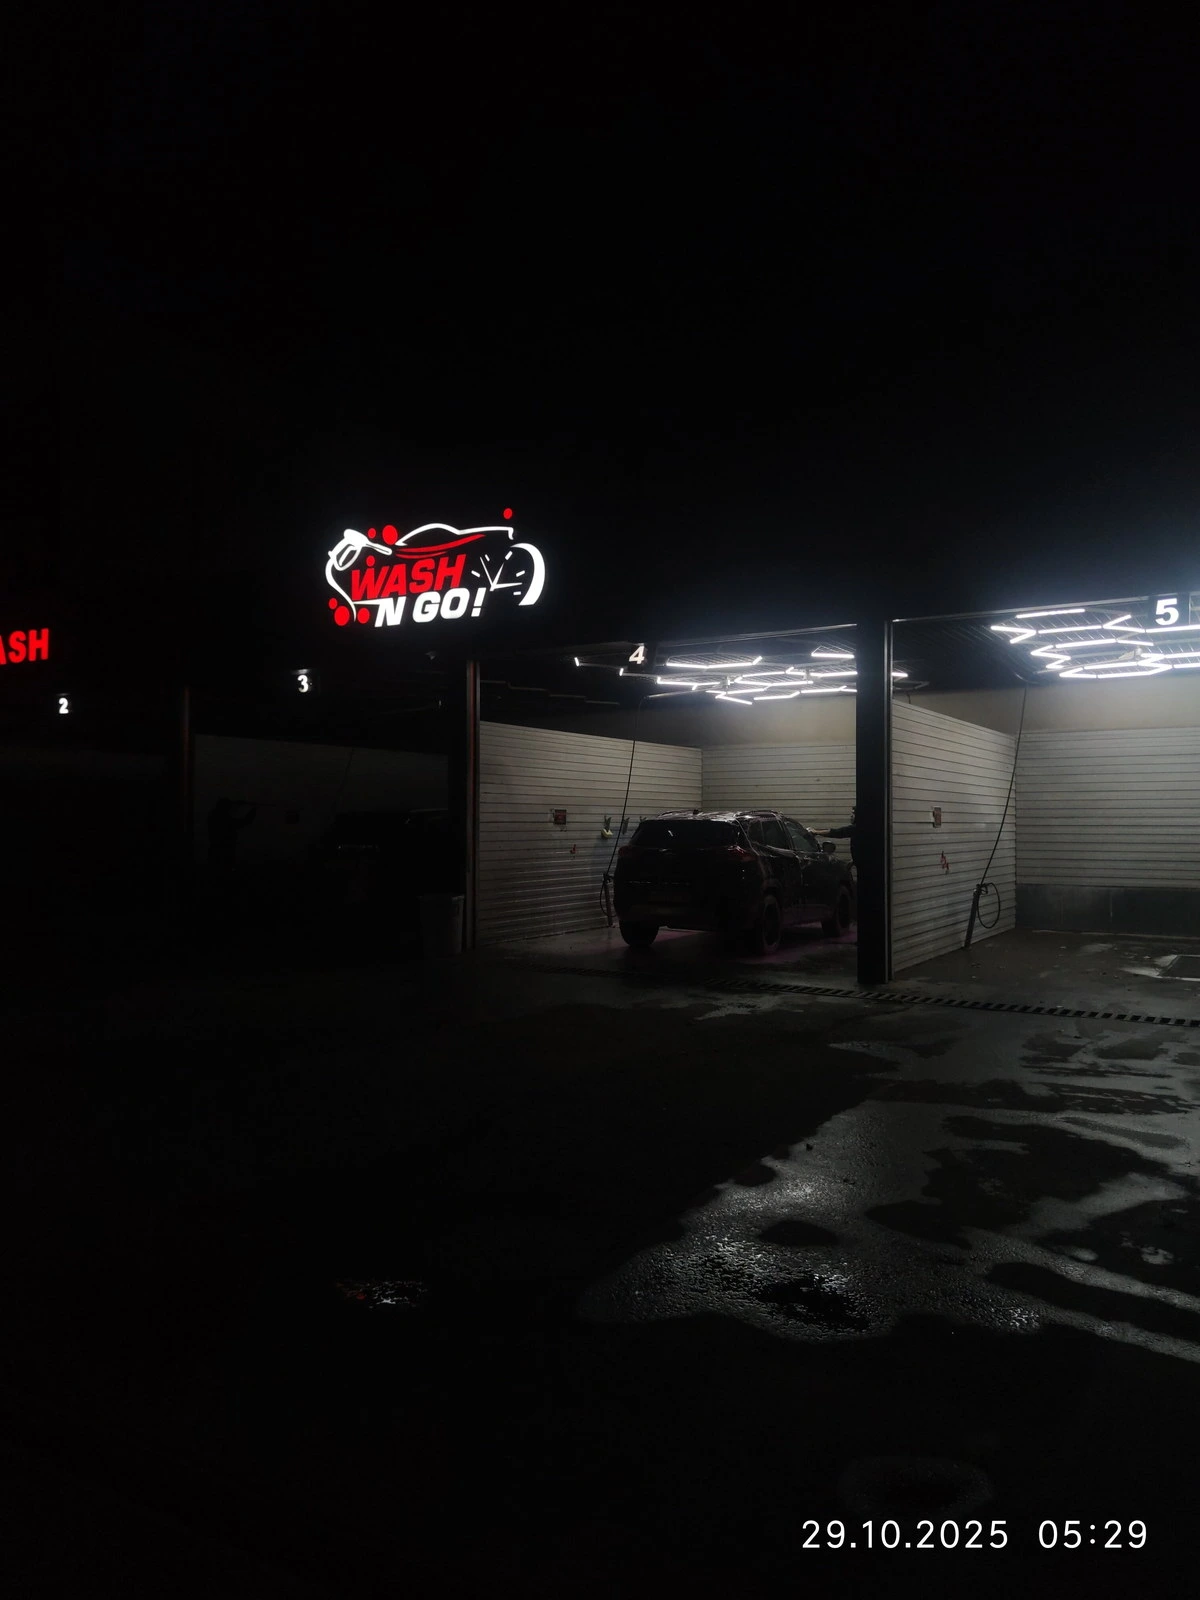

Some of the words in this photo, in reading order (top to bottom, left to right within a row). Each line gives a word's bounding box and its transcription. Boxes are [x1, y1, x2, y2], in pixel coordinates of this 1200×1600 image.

[351, 554, 467, 601] WASH
[373, 596, 407, 628] N
[412, 587, 487, 623] GO!
[1155, 597, 1180, 626] 5
[628, 644, 645, 665] 4
[297, 674, 309, 693] 3
[58, 697, 69, 714] 2
